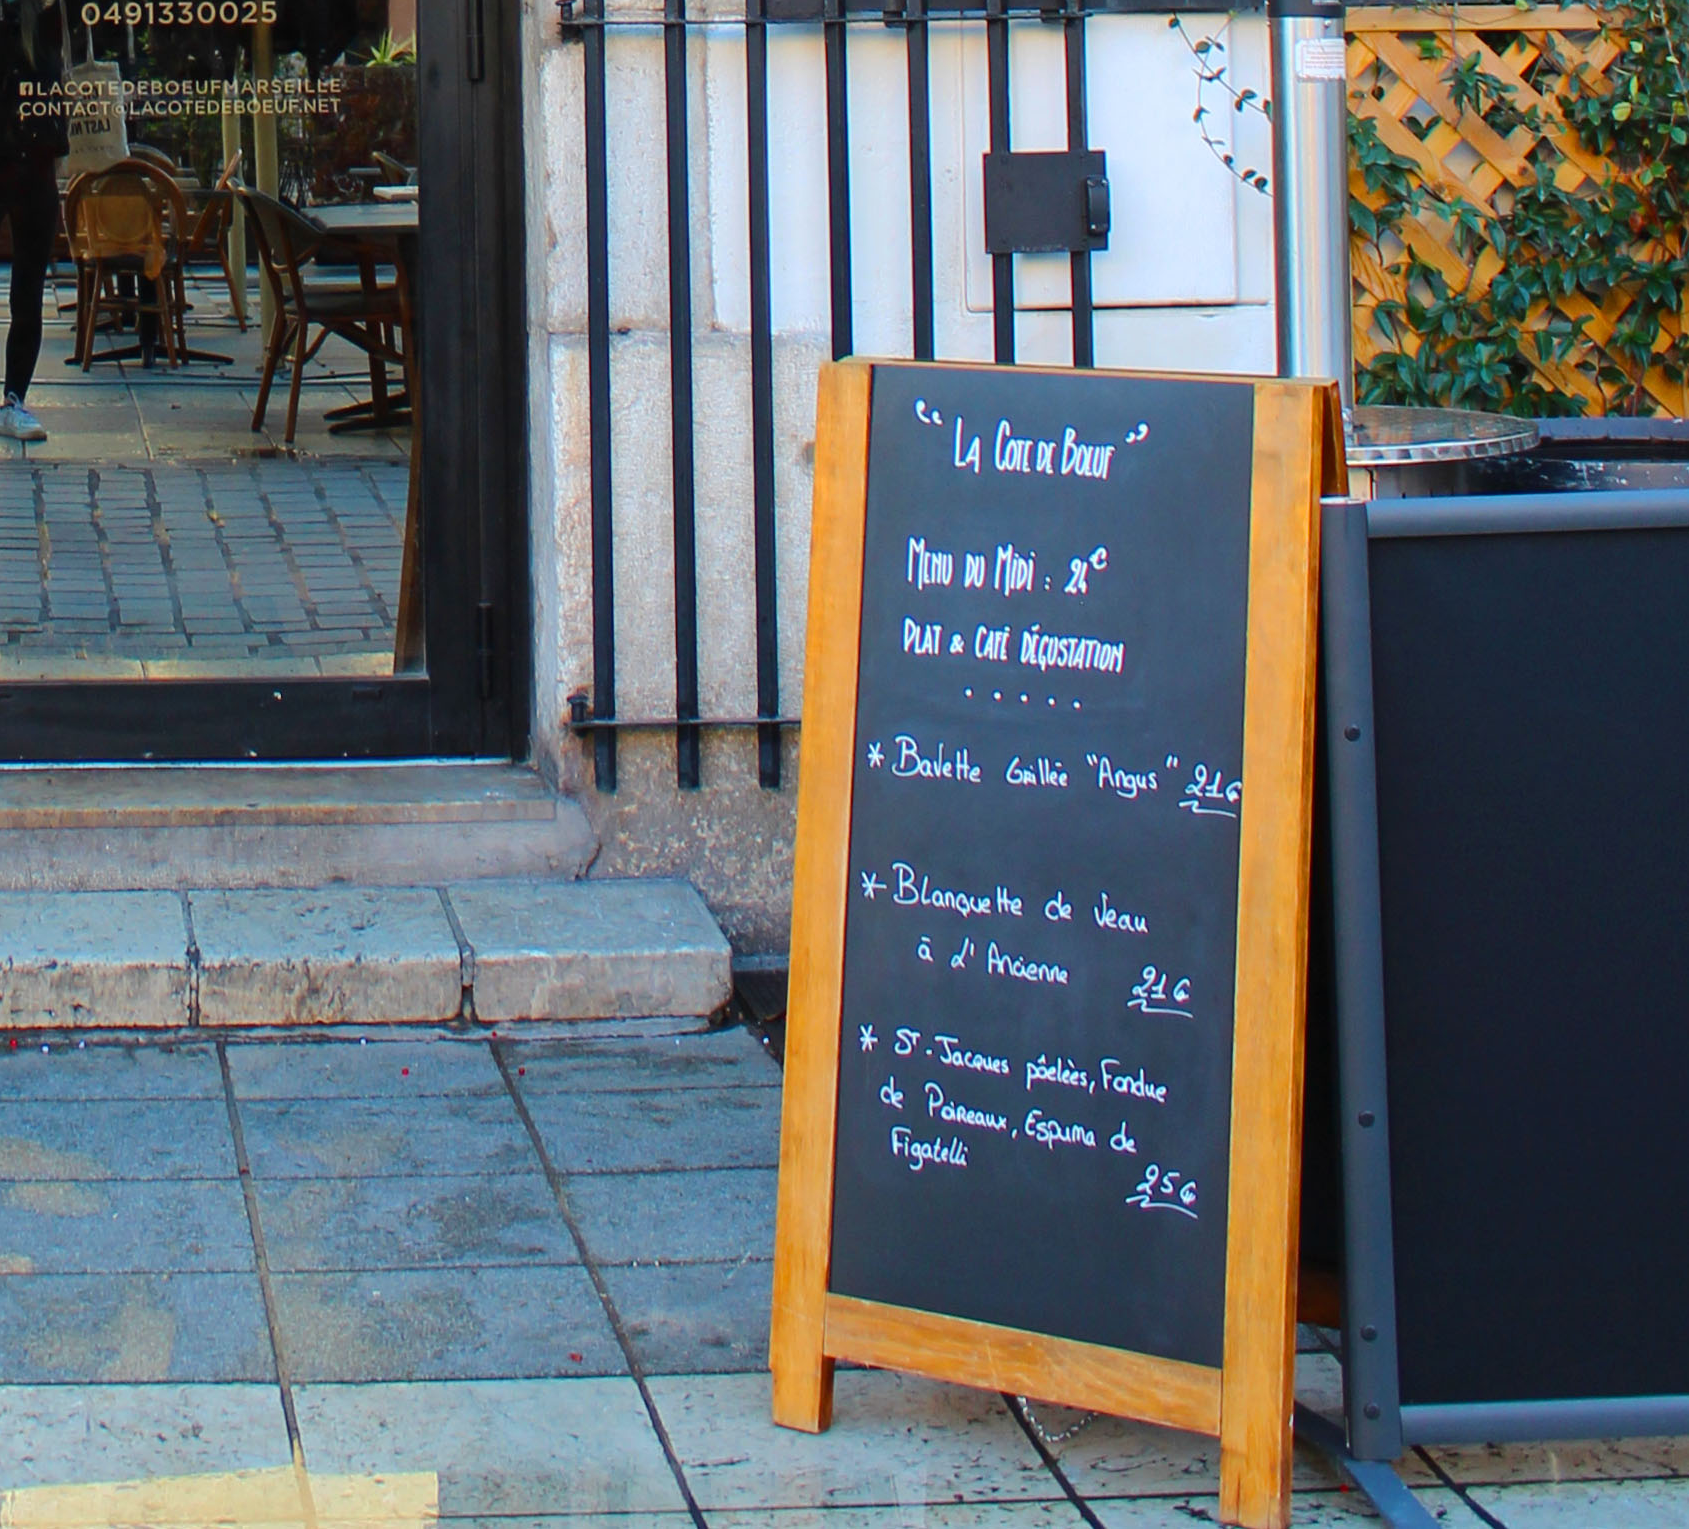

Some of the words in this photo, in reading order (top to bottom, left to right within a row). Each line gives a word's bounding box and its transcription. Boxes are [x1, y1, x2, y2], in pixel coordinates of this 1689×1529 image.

[80, 0, 278, 25] 0491330025
[18, 97, 342, 118] CONTACT@LACOTEDEBOEUF.NET
[907, 535, 954, 592] MENU
[963, 552, 986, 589] DU
[902, 615, 943, 656] PLAT
[1019, 622, 1126, 675] DÉGUSTATION
[891, 734, 982, 784] Bavette
[892, 862, 1024, 918] Blanquette
[1043, 891, 1073, 921] de
[1093, 892, 1149, 934] Veau
[1100, 1058, 1168, 1104] Fondue
[879, 1076, 905, 1109] de
[1024, 1108, 1097, 1151] Espuma
[1109, 1121, 1137, 1154] de
[889, 1126, 968, 1171] Figatelli
